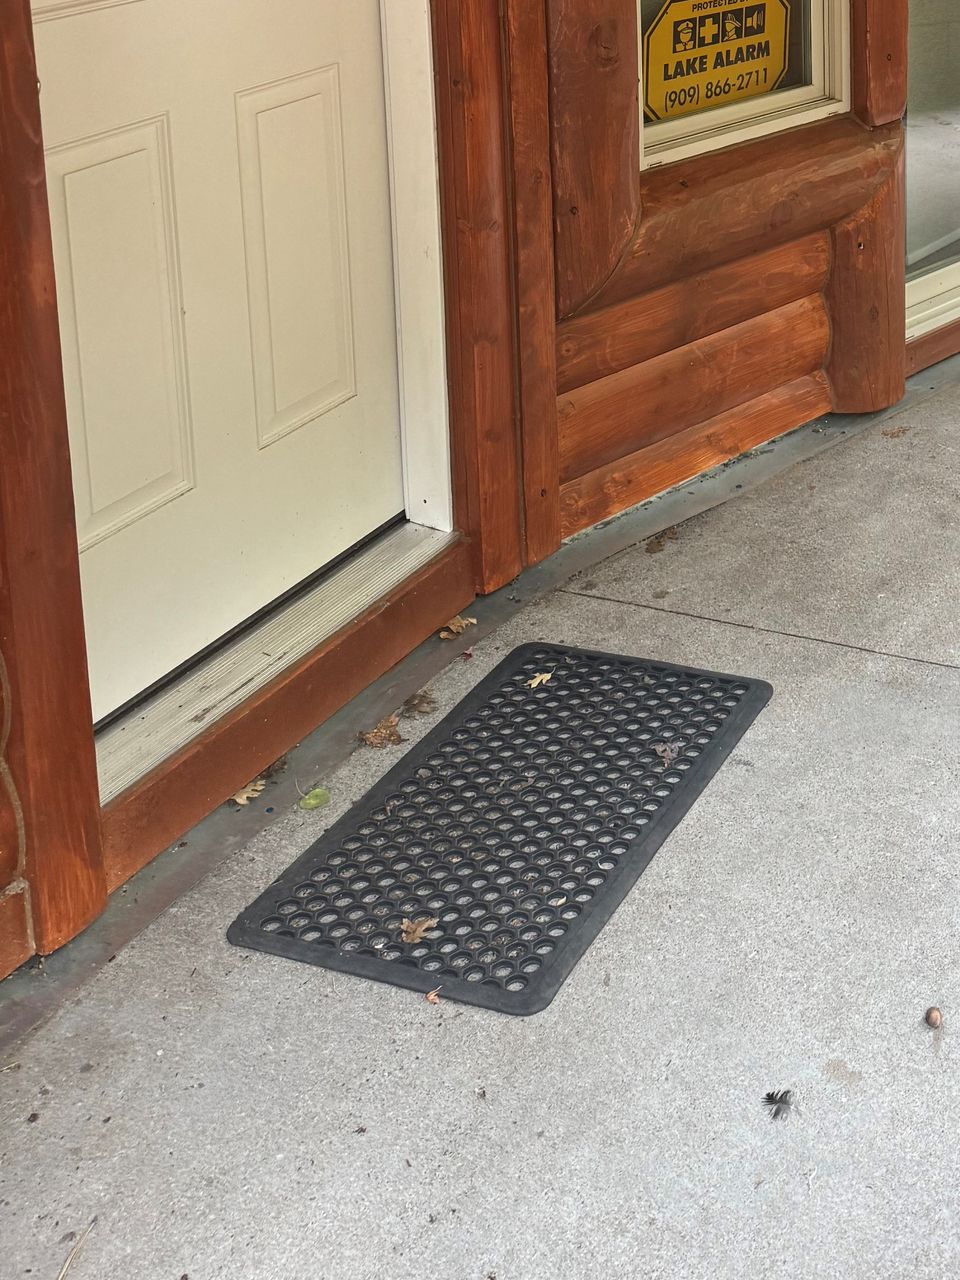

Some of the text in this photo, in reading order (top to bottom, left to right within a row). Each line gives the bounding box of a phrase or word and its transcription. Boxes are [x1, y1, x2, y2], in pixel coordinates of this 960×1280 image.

[663, 40, 770, 81] LAKE ALARM
[664, 67, 768, 113] (909) 866-2711
